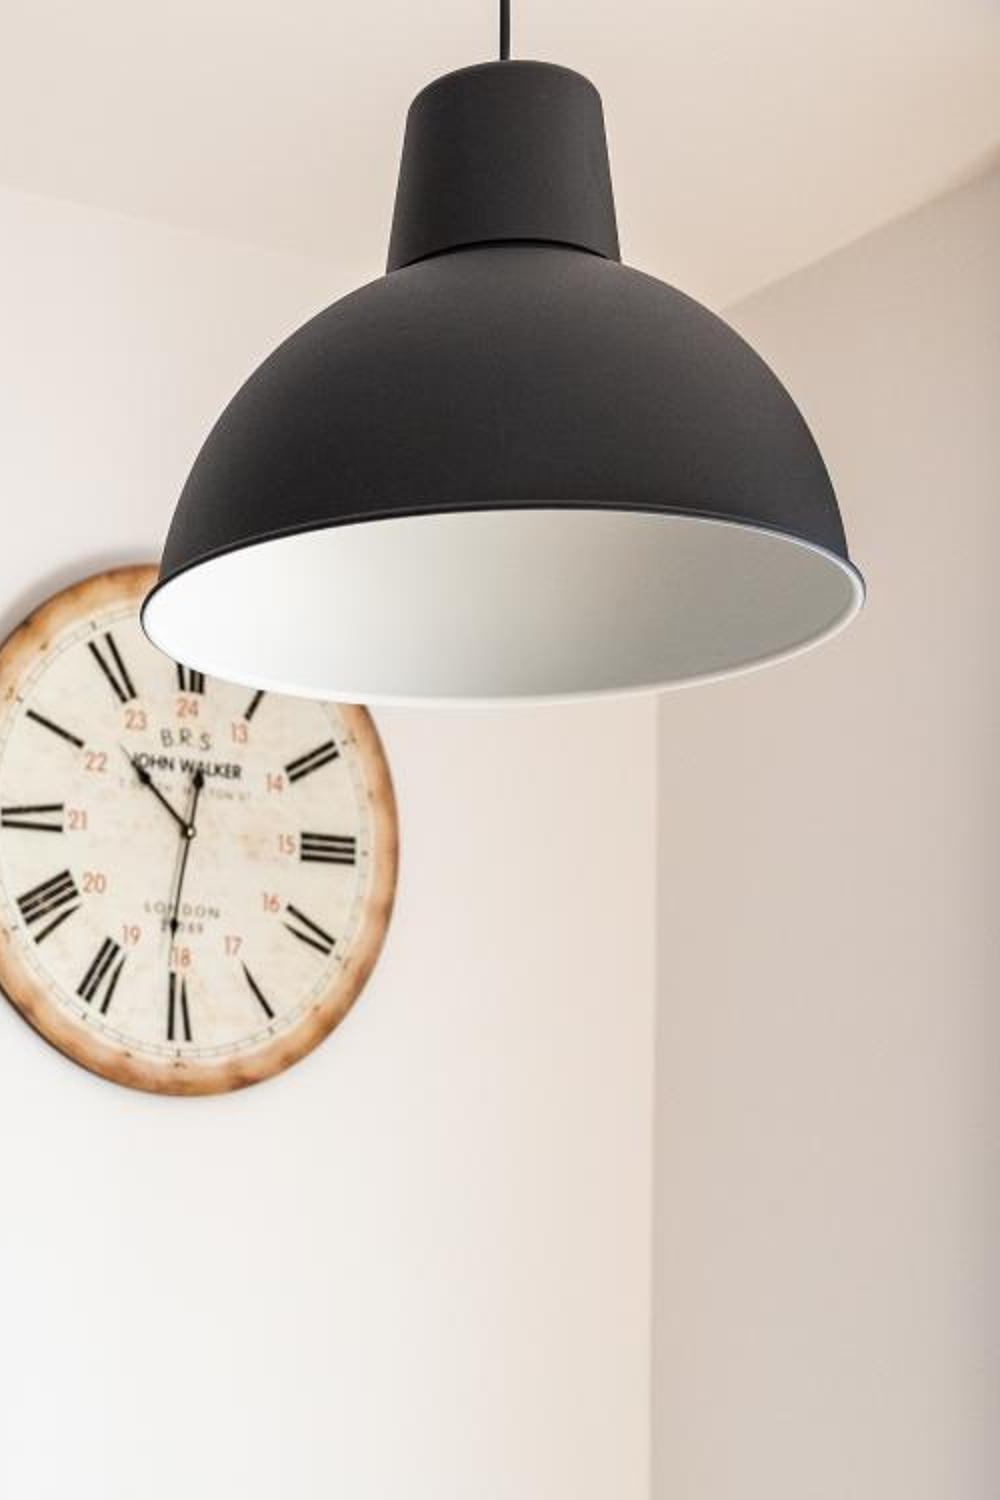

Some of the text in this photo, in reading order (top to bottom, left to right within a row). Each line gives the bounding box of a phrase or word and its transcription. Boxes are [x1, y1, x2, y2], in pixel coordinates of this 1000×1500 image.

[177, 697, 199, 718] 24
[124, 709, 148, 731] 23
[231, 722, 249, 745] 13
[84, 752, 108, 773] 22
[133, 751, 242, 780] JOHN WALKER
[266, 772, 284, 793] 14
[67, 810, 88, 831] 21
[279, 834, 296, 855] 15
[83, 872, 107, 893] 20
[261, 893, 281, 915] 16
[122, 925, 142, 945] 19
[224, 935, 243, 956] 17
[171, 946, 192, 968] 18
